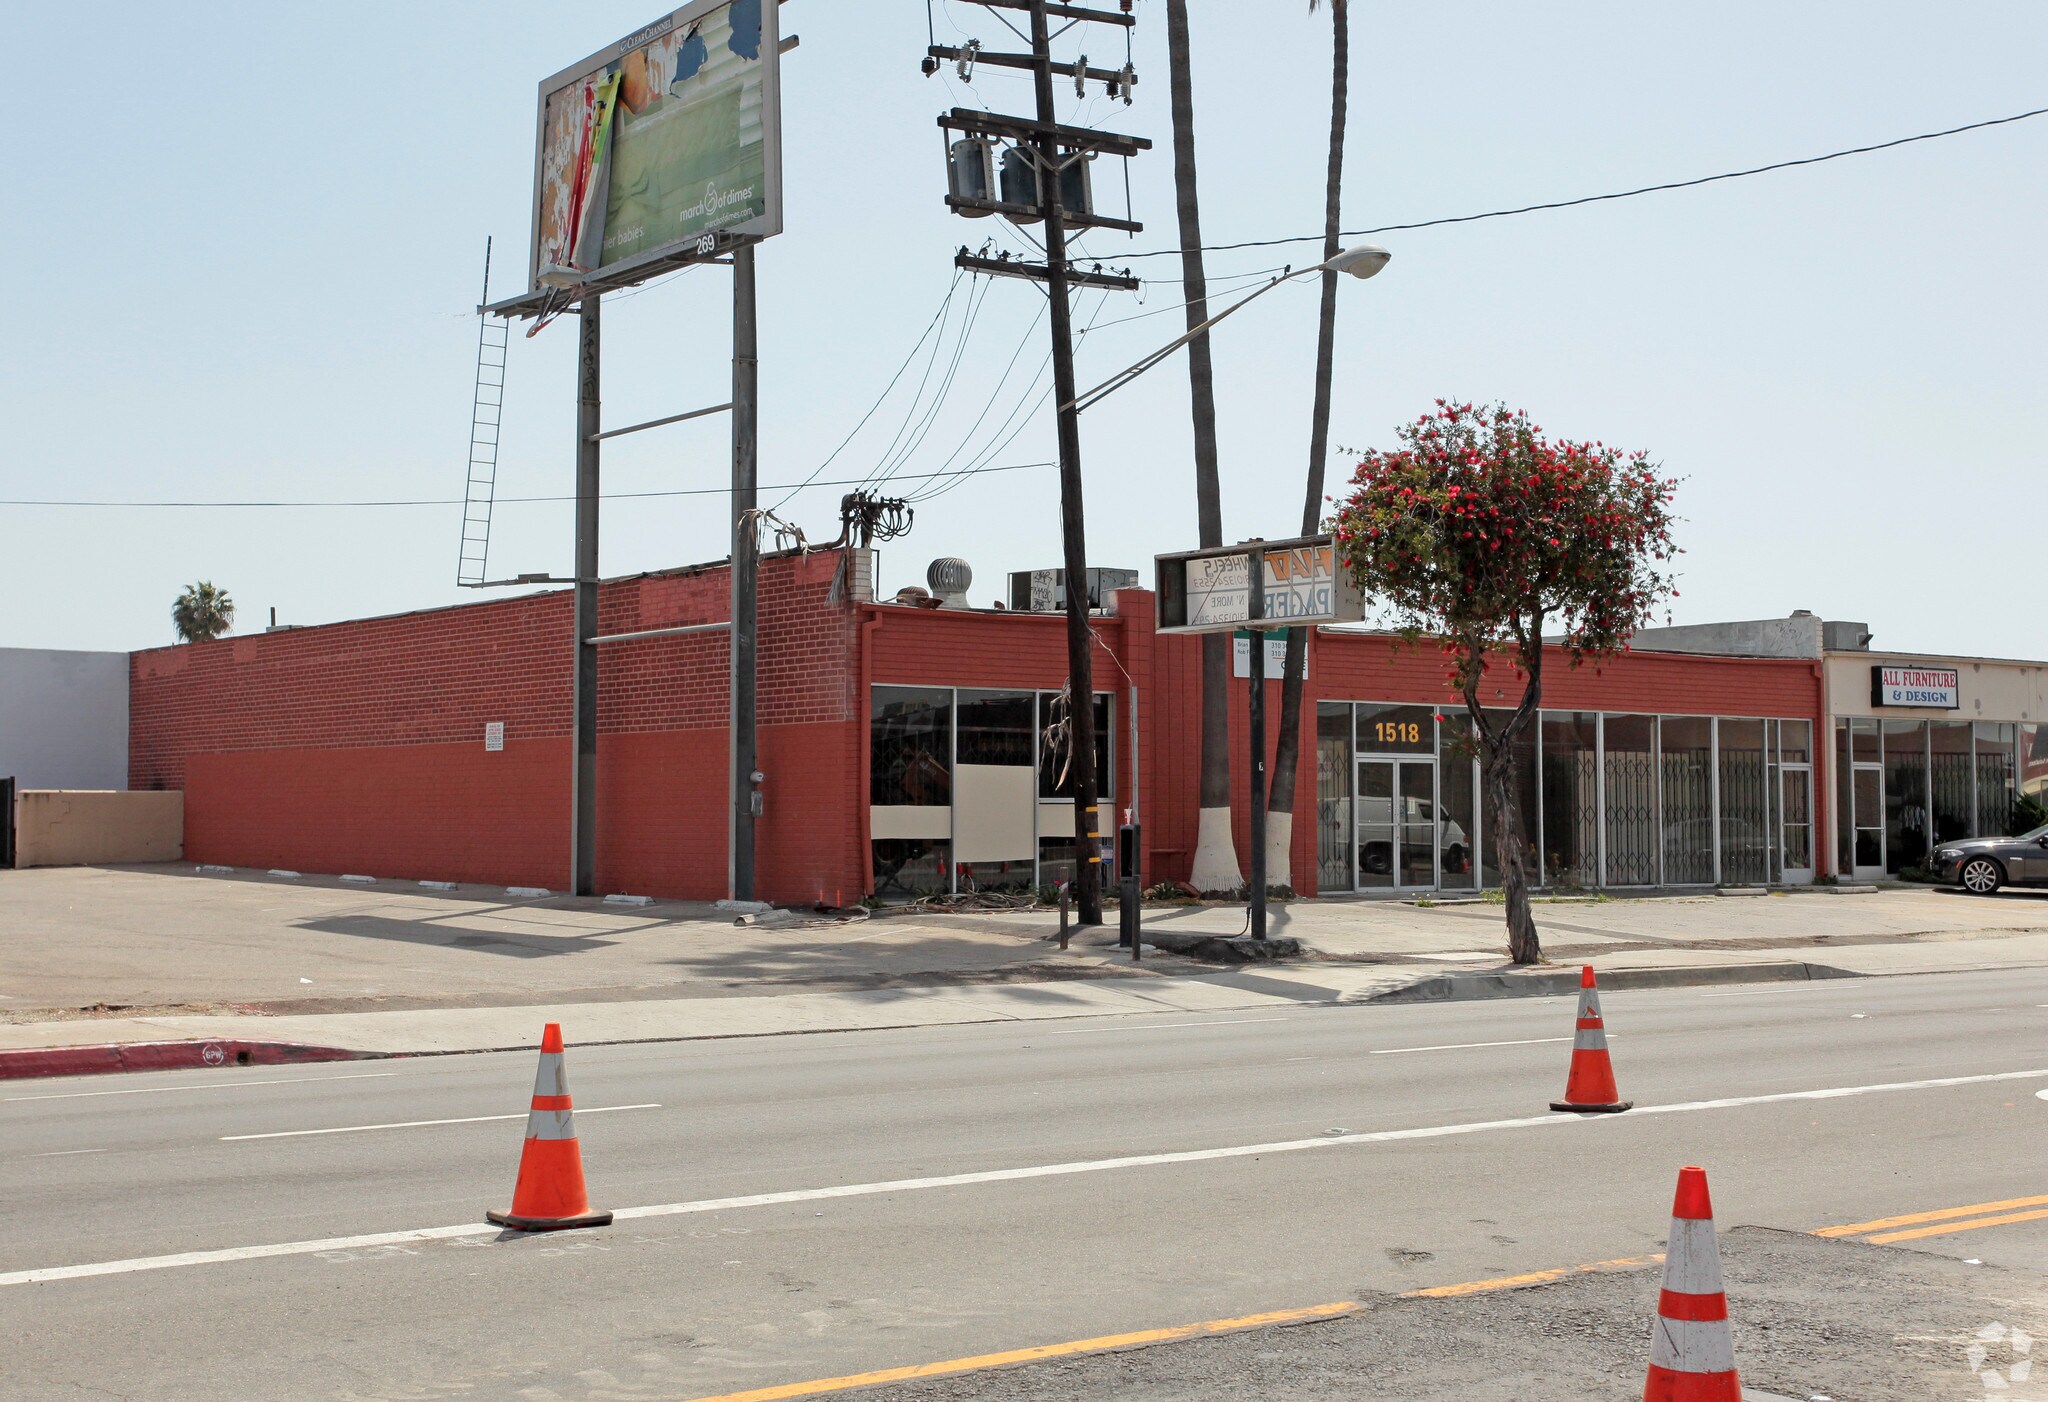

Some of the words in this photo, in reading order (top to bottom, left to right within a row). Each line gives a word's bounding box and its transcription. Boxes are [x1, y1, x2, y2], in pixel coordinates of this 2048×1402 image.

[680, 200, 704, 221] march
[696, 234, 715, 255] 269
[1882, 670, 1900, 686] ALL
[1902, 671, 1956, 688] FURNITURE
[1892, 690, 1901, 701] &
[1905, 691, 1947, 703] DESIGN
[1375, 722, 1419, 743] 1518
